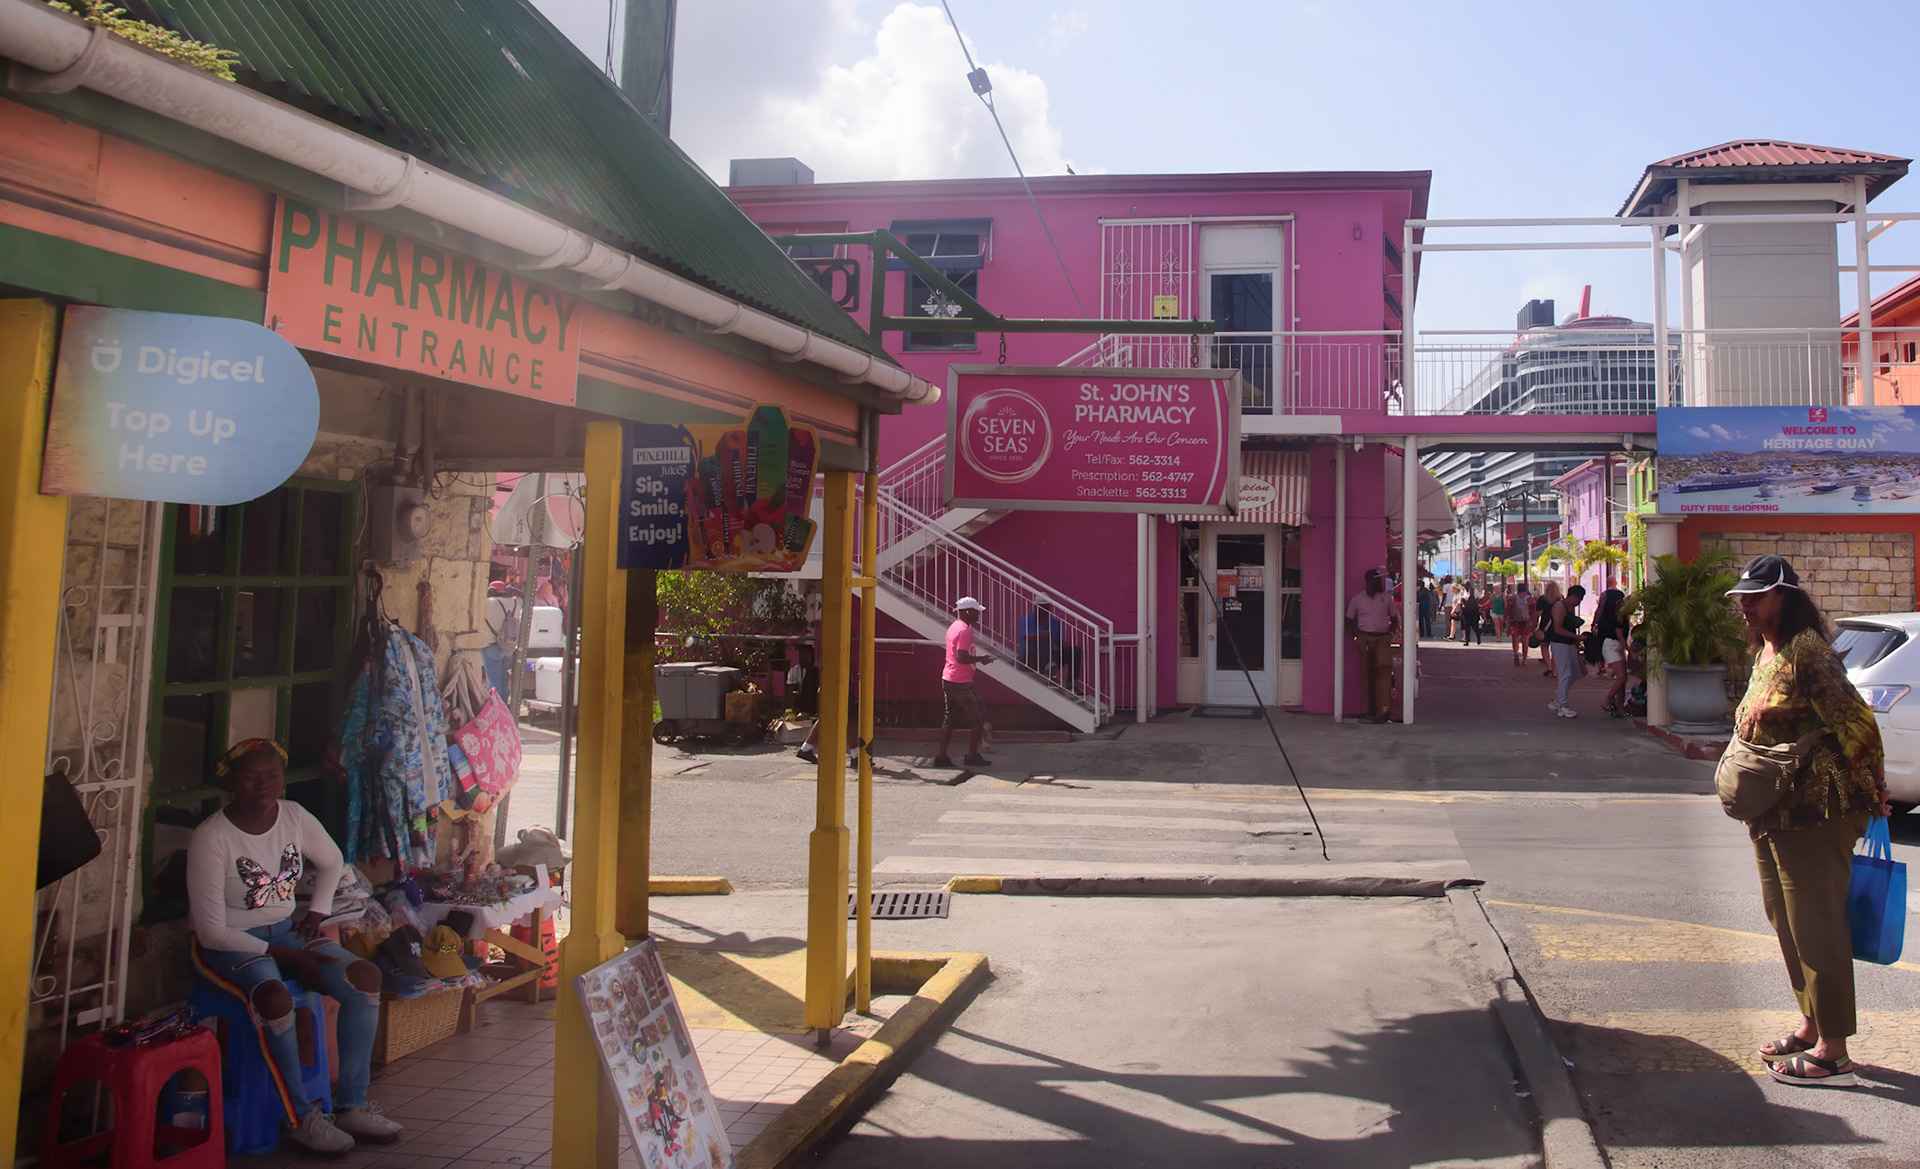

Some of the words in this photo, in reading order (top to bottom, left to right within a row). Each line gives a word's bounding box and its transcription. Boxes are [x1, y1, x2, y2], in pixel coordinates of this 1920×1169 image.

[278, 204, 576, 352] PHARMACY
[322, 304, 544, 391] ENTRANCE
[137, 346, 265, 385] Digicel
[1080, 383, 1104, 401] St.
[1110, 384, 1190, 402] JOHN'S
[105, 402, 171, 439] Top
[188, 409, 236, 444] Up
[1075, 405, 1195, 424] PHARMACY
[978, 417, 1035, 434] SEVEN
[1782, 426, 1838, 435] WELCOME
[1840, 426, 1856, 435] TO
[983, 435, 1028, 453] SEAS
[1063, 430, 1090, 450] Your
[1091, 430, 1121, 444] Needs
[1121, 432, 1143, 444] Are
[1145, 432, 1166, 444] Our
[1167, 433, 1209, 446] Concern
[1763, 438, 1834, 449] HERITAGE
[1837, 438, 1876, 449] QUAY
[118, 443, 207, 476] Here
[636, 450, 687, 461] PINEHILL
[1085, 454, 1125, 466] Tel/Fax:
[1129, 455, 1180, 466] 562-3314
[1072, 470, 1138, 482] Prescription:
[1142, 471, 1194, 482] 562-4747
[635, 476, 669, 495] Sip,
[1077, 486, 1132, 497] Snackette:
[1135, 488, 1187, 498] 562-3313
[1239, 483, 1270, 493] pion
[630, 500, 684, 517] Smile,
[629, 523, 682, 545] Enjoy!
